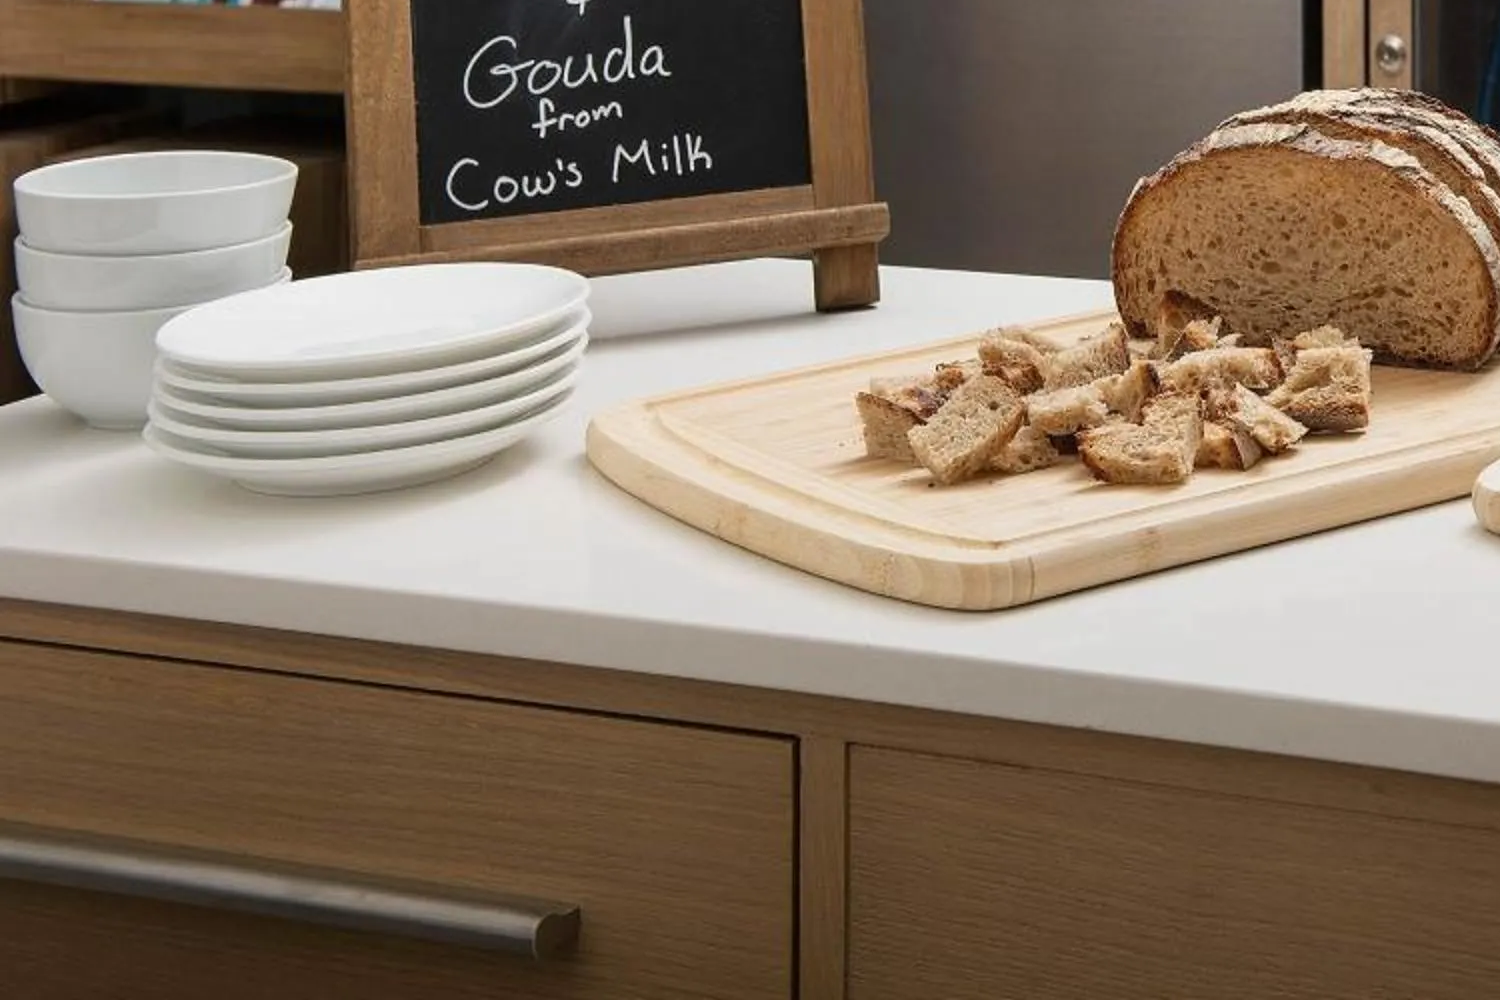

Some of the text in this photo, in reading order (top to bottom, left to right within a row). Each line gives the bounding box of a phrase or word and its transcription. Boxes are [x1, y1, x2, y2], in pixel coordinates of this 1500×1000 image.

[463, 15, 672, 109] Gouda
[531, 97, 623, 139] from
[445, 133, 713, 210] Cow's Milk
